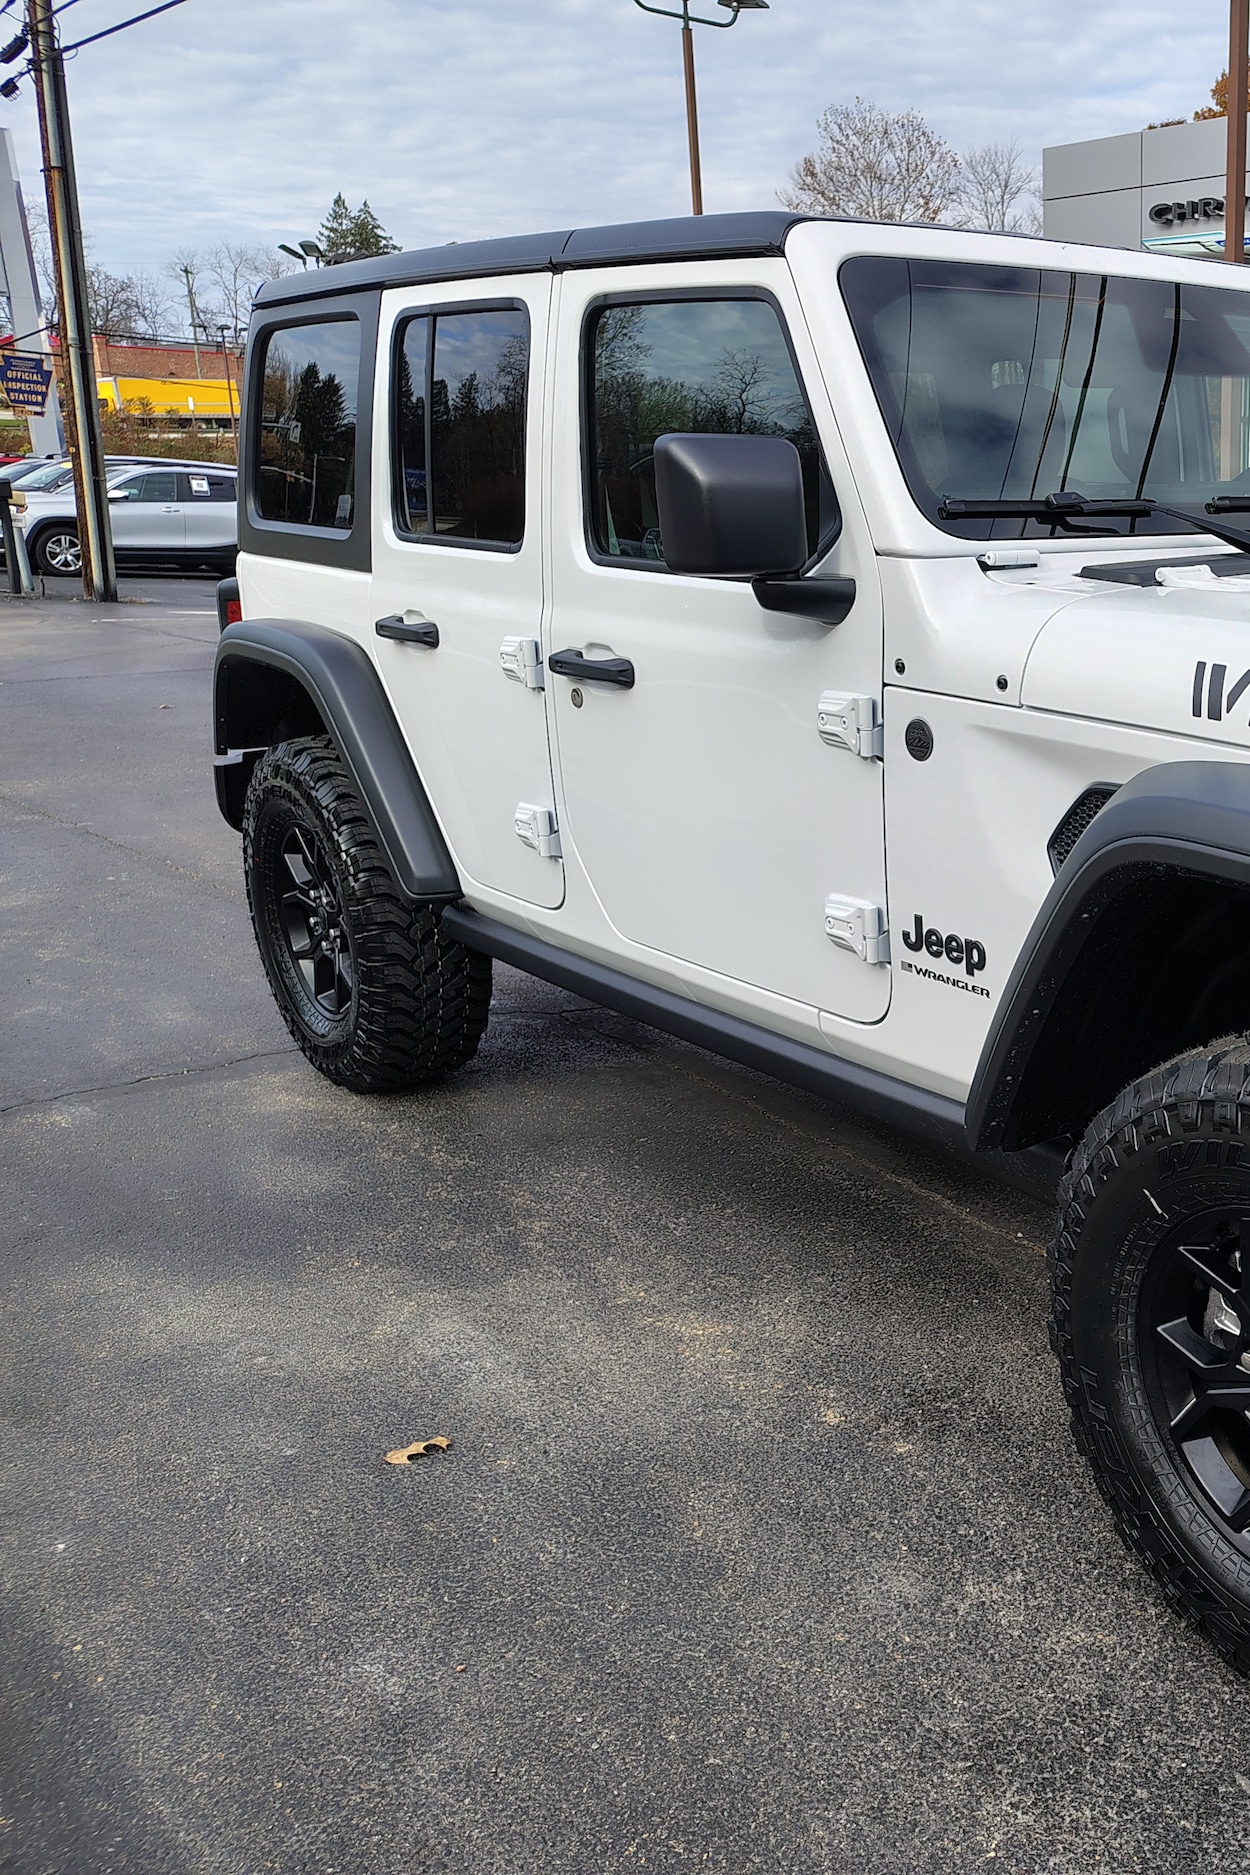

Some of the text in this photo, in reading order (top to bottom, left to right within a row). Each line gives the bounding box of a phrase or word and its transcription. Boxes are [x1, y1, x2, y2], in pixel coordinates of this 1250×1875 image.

[6, 370, 43, 382] OFFICIAL
[3, 380, 47, 393] INSPECTION
[10, 391, 43, 403] STATION
[902, 913, 986, 977] Jeep
[913, 964, 991, 999] WRANGLER
